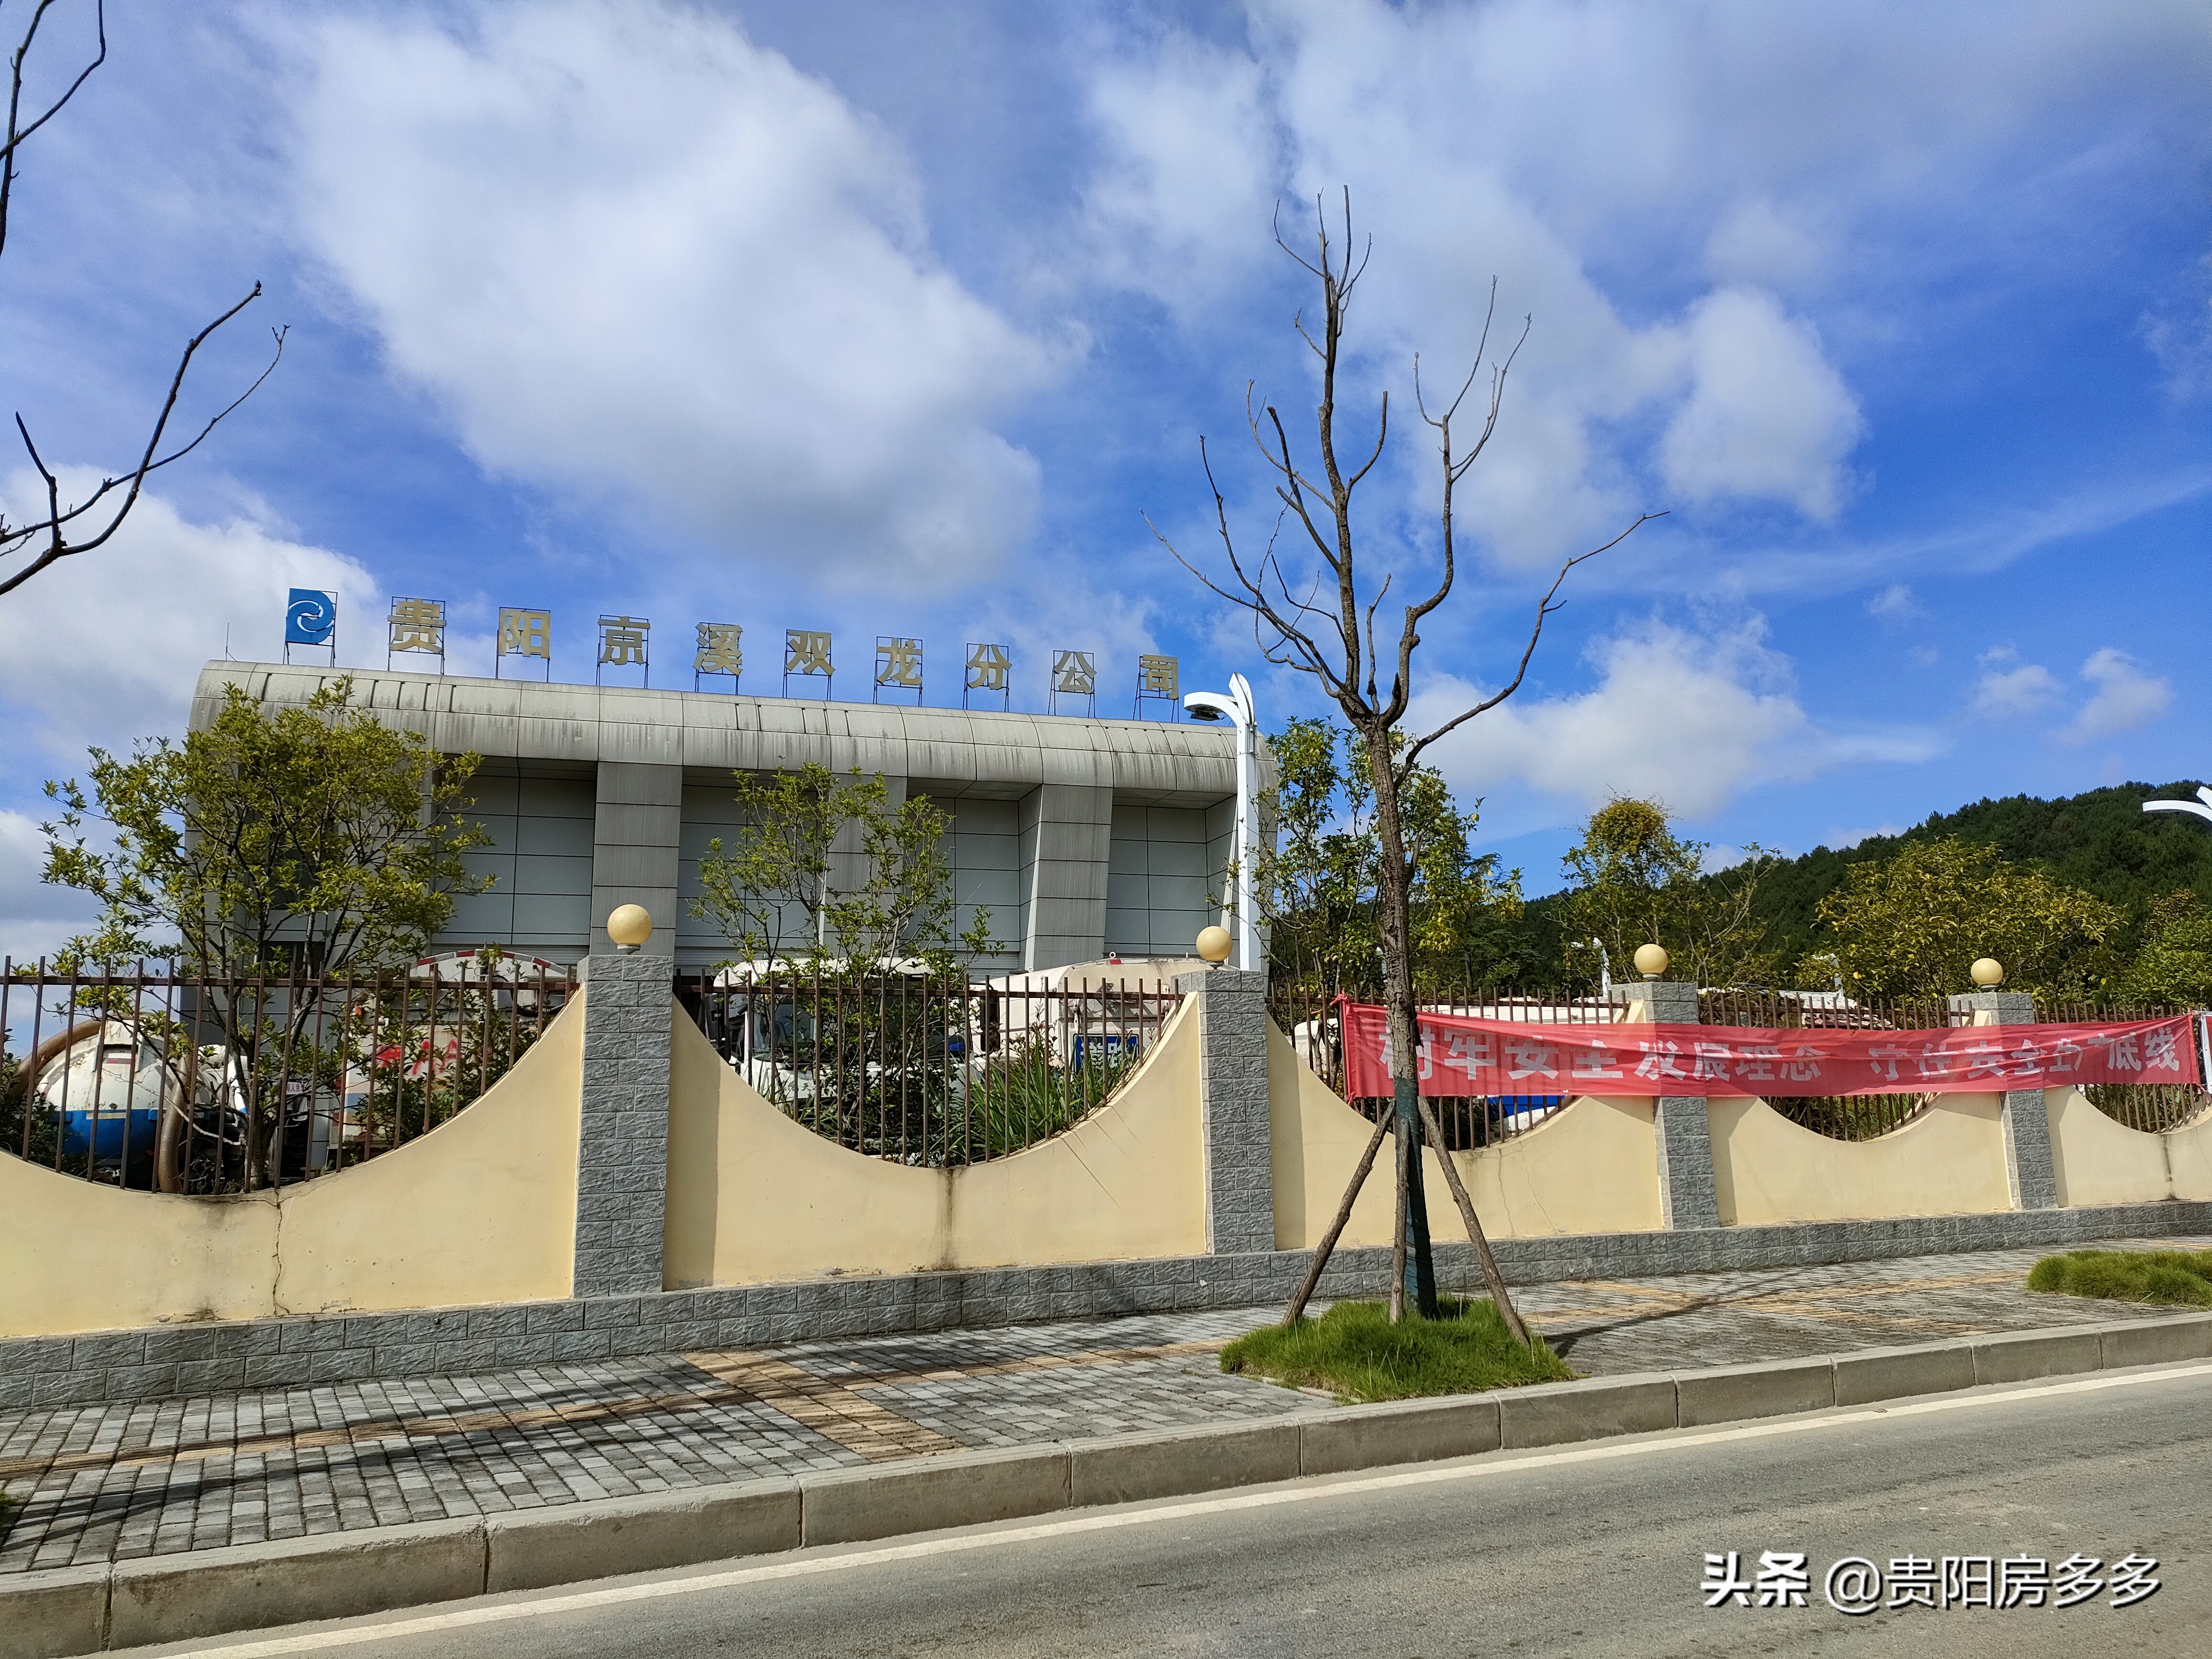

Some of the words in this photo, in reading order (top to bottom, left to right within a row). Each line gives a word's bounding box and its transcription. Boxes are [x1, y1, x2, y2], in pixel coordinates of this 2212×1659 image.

[387, 598, 1179, 699] 贵阳京溪双龙分公司
